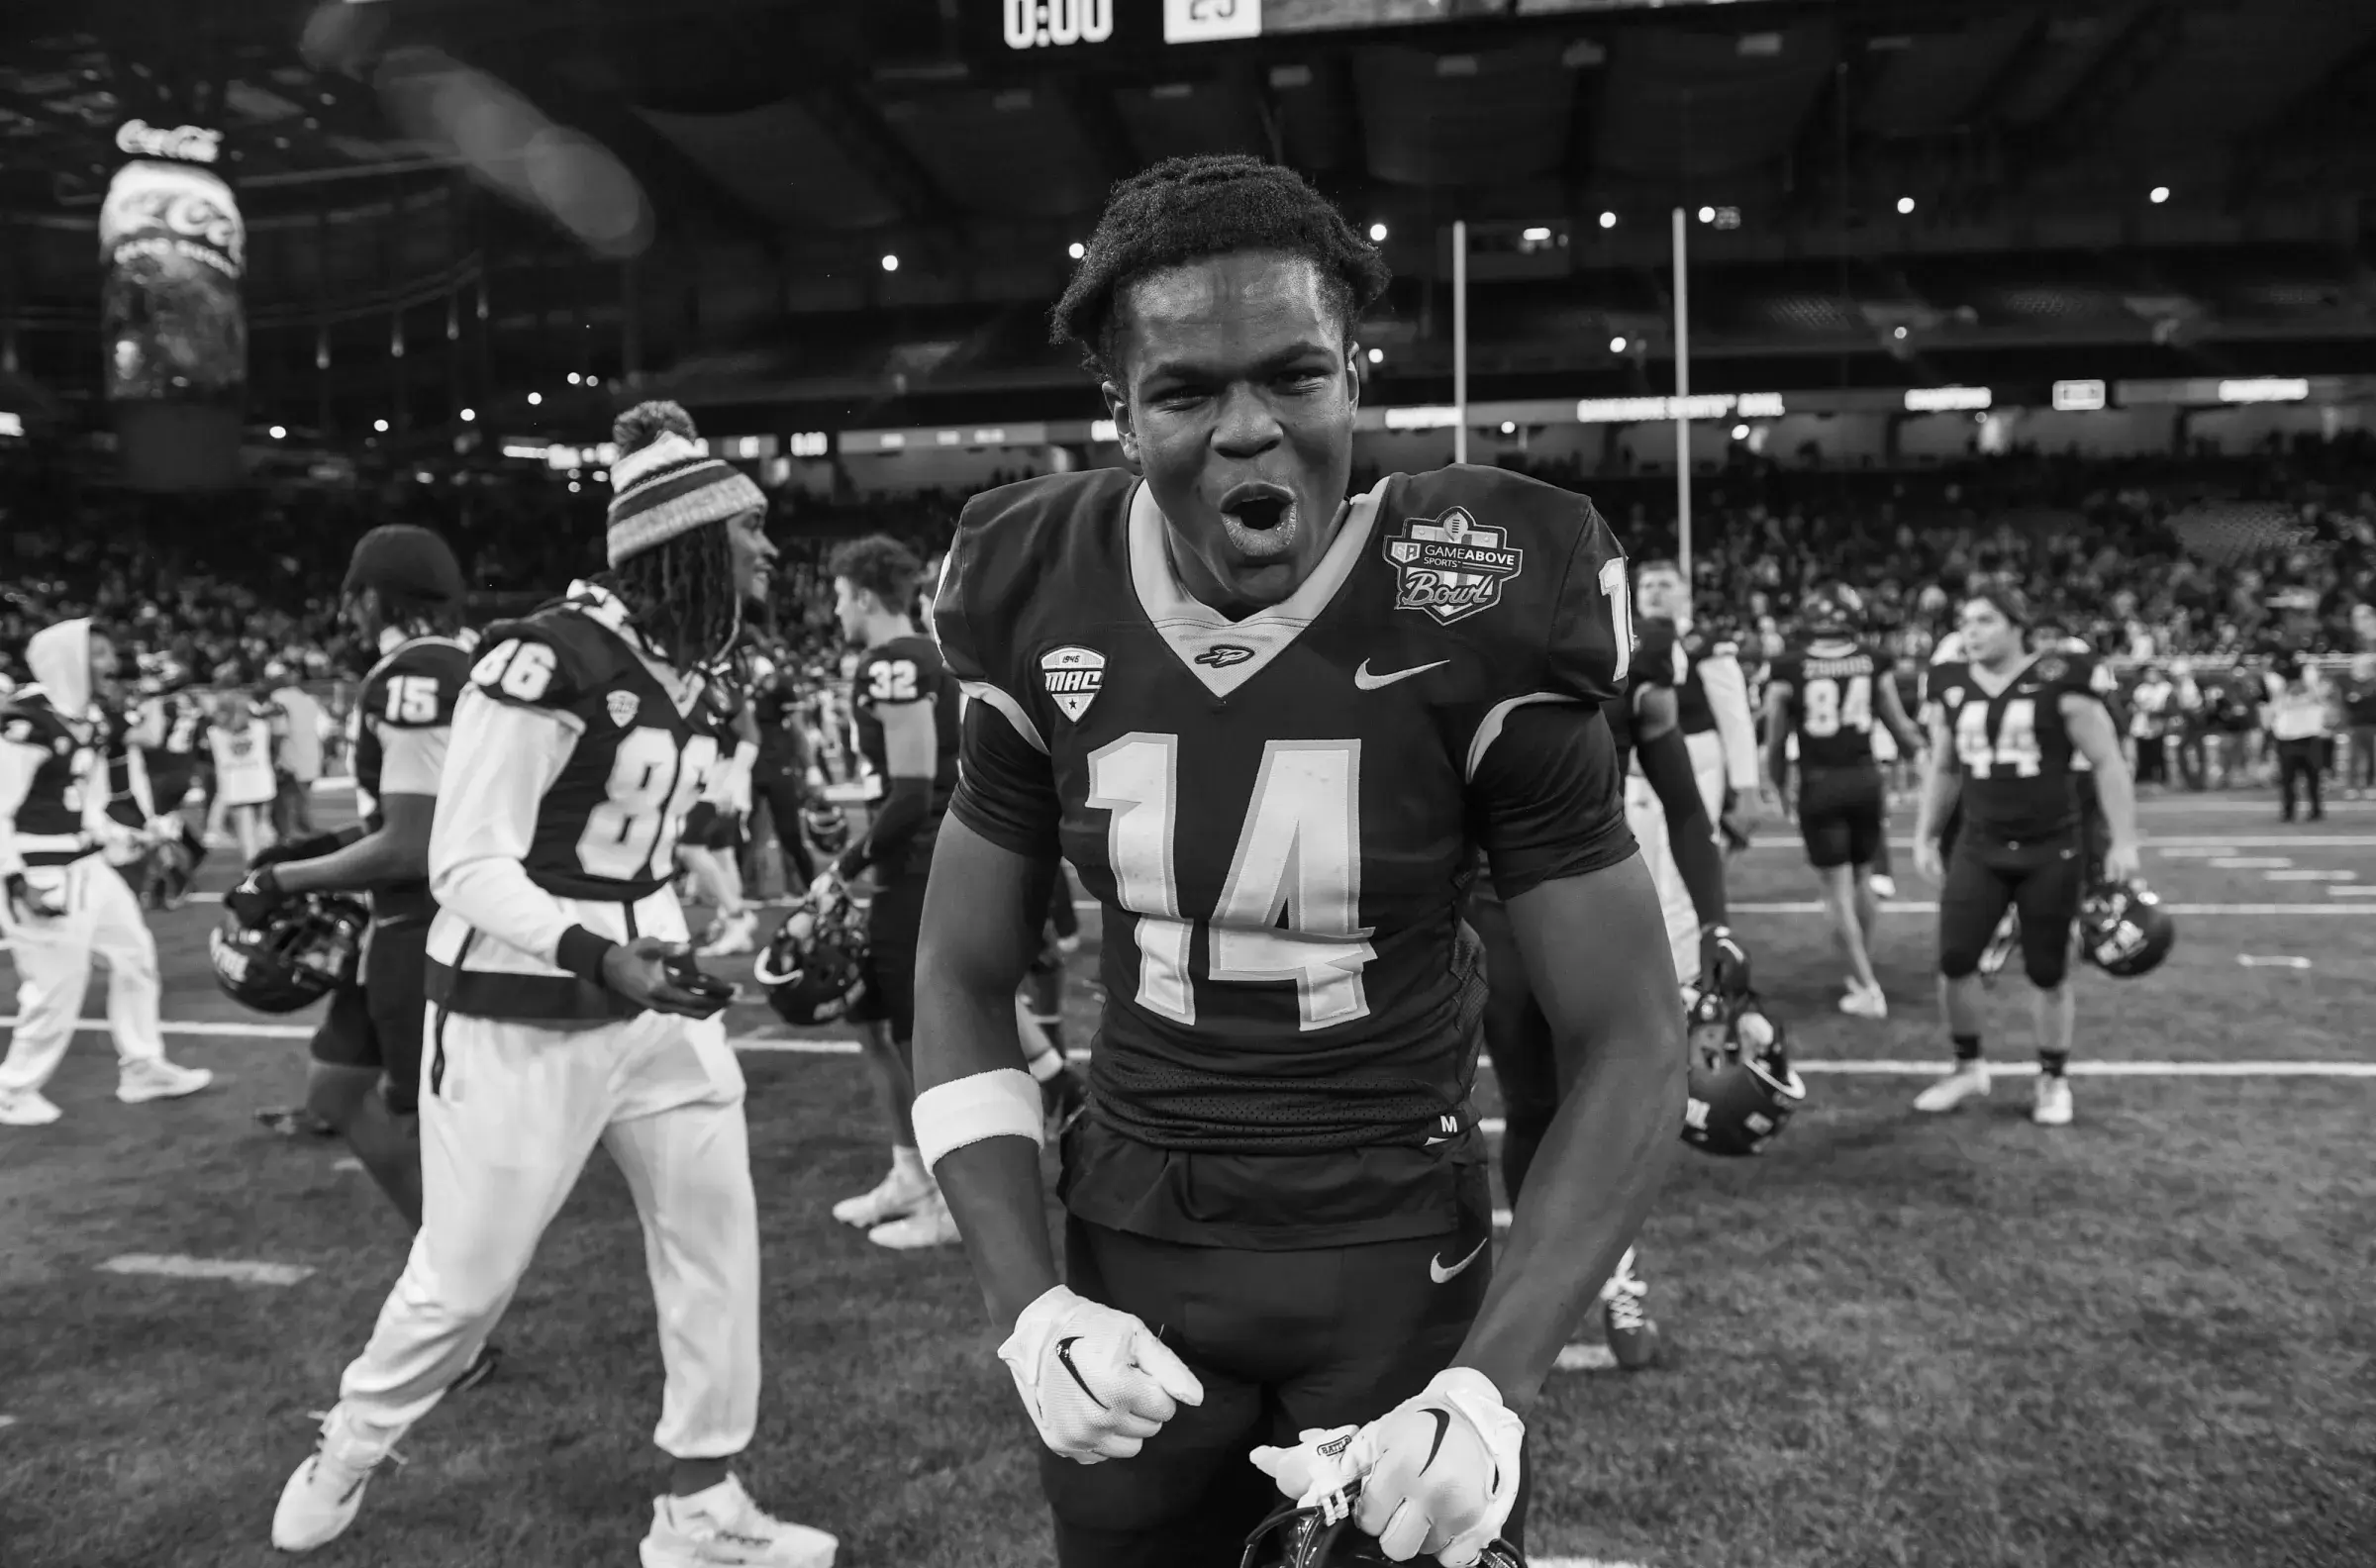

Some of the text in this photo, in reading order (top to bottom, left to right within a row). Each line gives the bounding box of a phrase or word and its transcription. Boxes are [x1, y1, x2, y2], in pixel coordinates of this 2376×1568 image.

[1424, 556, 1458, 568] SPORTS
[1425, 544, 1516, 565] GAMEABOVE
[1402, 574, 1494, 606] Bowl
[1598, 556, 1636, 682] 1
[385, 674, 440, 724] 15
[868, 659, 918, 699] 32
[1044, 670, 1103, 692] MAC
[1803, 675, 1872, 738] 84
[1955, 698, 2042, 779] 44
[1085, 732, 1378, 1031] 14
[1440, 1115, 1458, 1133] M
